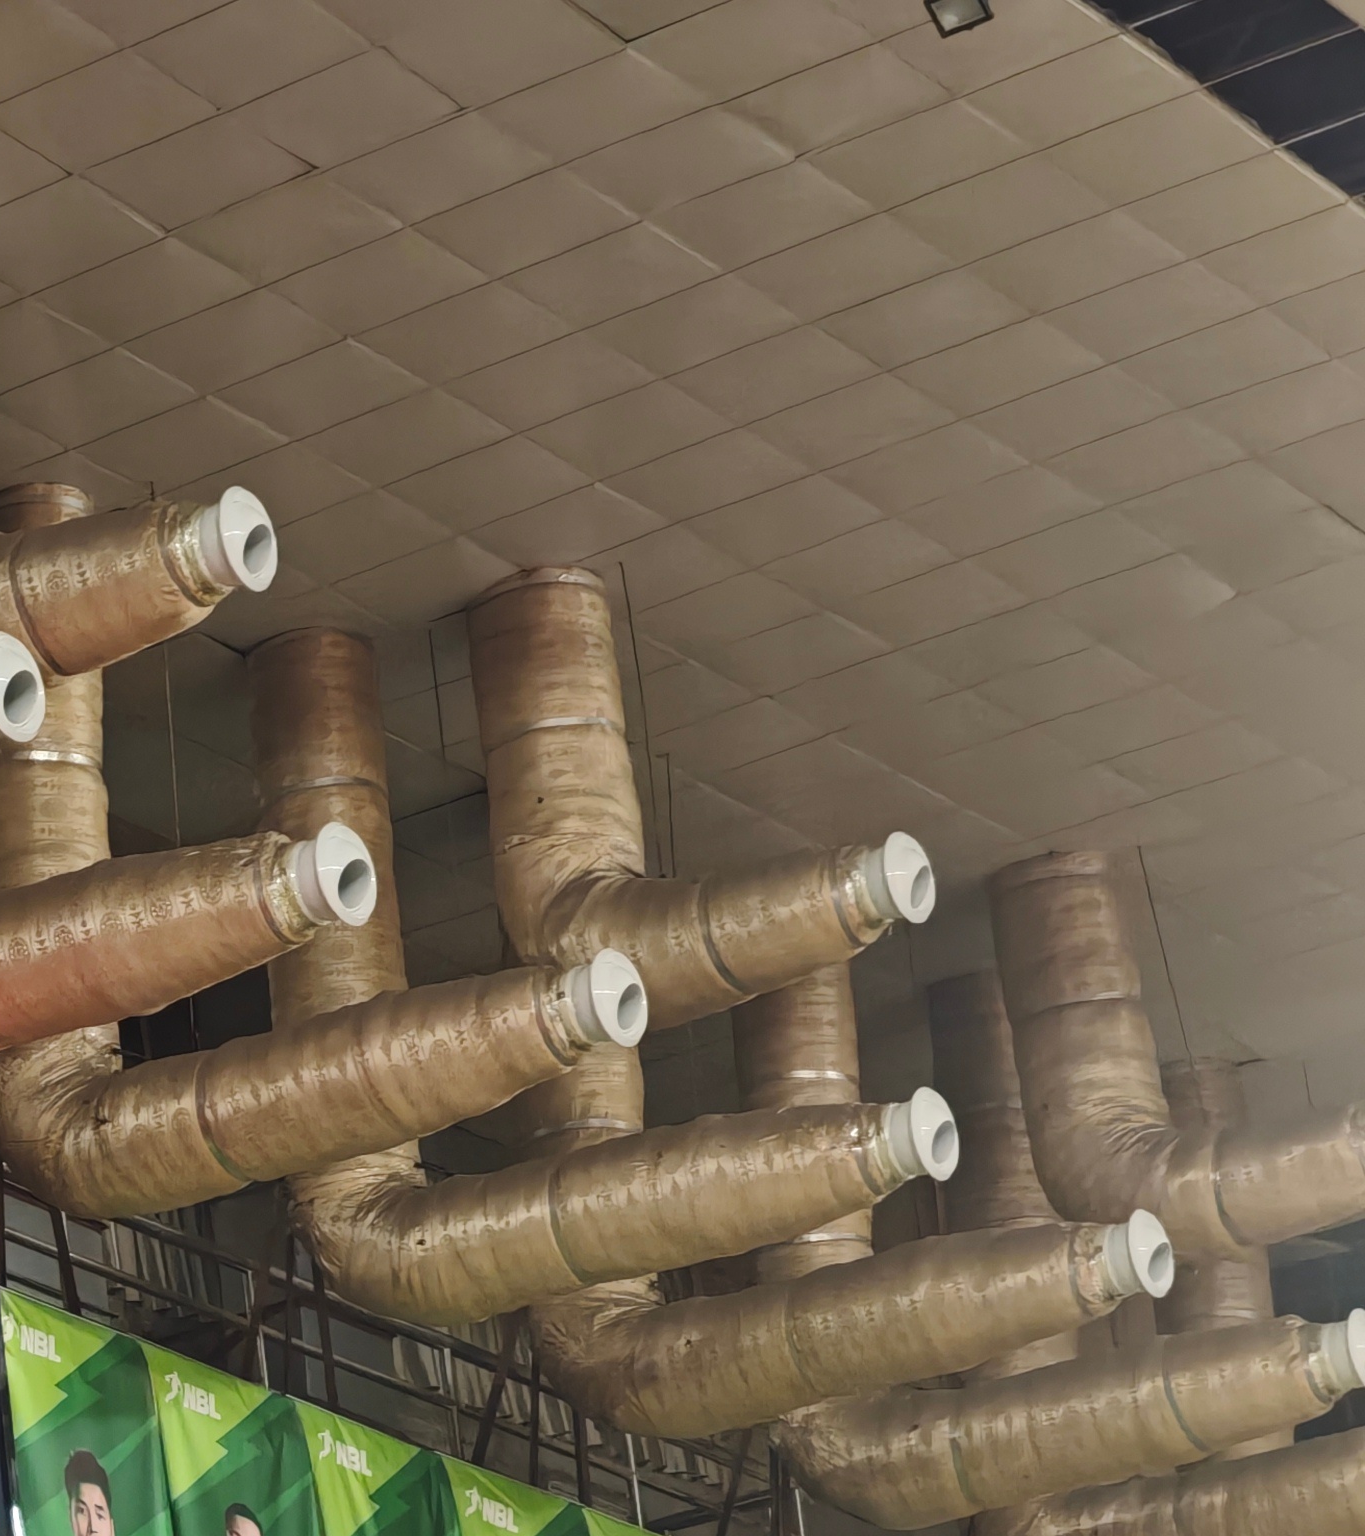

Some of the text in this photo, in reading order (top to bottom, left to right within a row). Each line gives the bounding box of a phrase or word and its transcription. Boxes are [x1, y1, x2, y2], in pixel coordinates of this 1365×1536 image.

[19, 1326, 62, 1363] NBL
[182, 1385, 221, 1421] NBL
[335, 1442, 373, 1477] NBL
[482, 1499, 519, 1534] NBL
